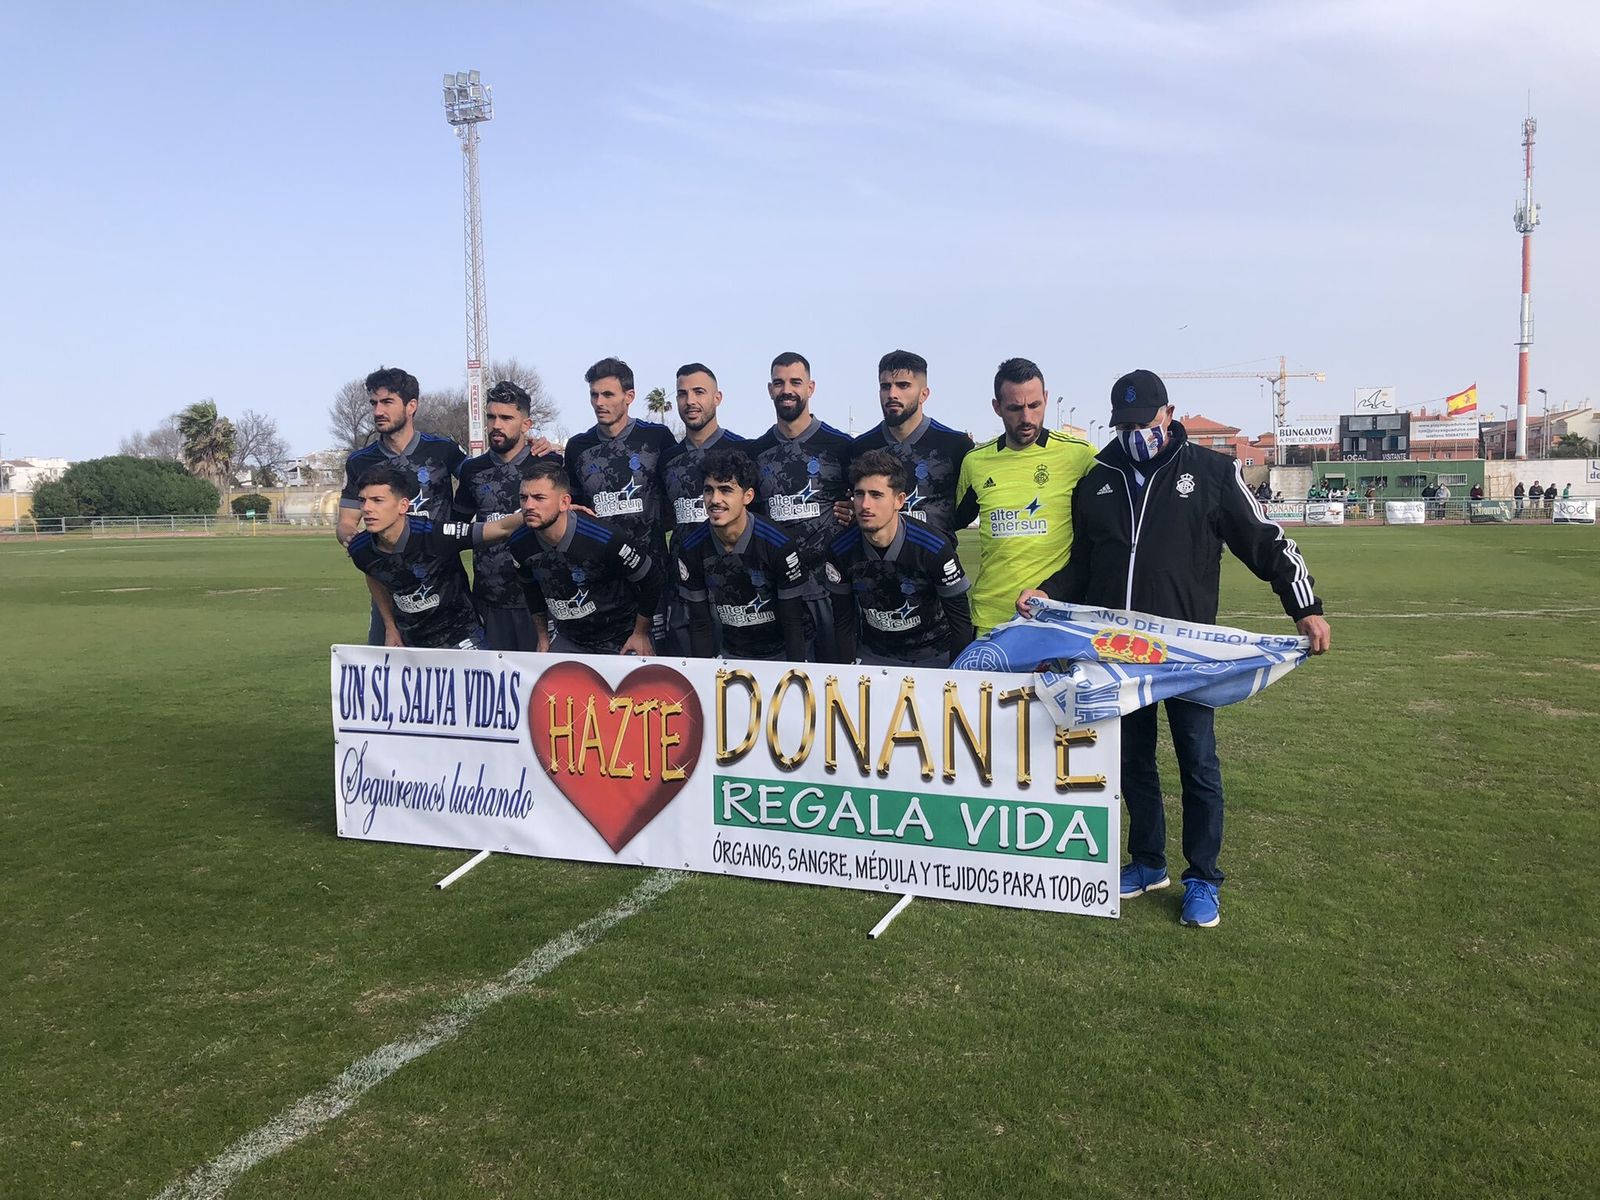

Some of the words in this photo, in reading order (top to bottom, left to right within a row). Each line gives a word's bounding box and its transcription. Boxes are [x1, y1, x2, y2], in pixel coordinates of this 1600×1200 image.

[1279, 427, 1333, 437] BUNGALOWS
[1382, 453, 1407, 461] VISITANTE
[593, 491, 621, 504] alter
[674, 497, 698, 509] alter
[769, 494, 795, 507] alter
[595, 499, 643, 513] enersun
[770, 503, 819, 518] enersun
[1268, 504, 1303, 512] DONANTE
[990, 509, 1020, 521] alter
[991, 519, 1047, 532] enersun
[1134, 618, 1166, 634] DEL
[339, 664, 366, 721] UN
[371, 653, 394, 729] SÍ,
[400, 666, 457, 726] SALVA
[464, 668, 520, 731] VIDAS
[715, 667, 1107, 790] DONANTE
[549, 694, 686, 781] HAZTE
[340, 741, 446, 834] Seguiremos
[450, 762, 534, 820] luchando
[721, 780, 934, 841] REGALA
[959, 801, 1099, 857] VIDA
[712, 833, 785, 873] ÓRGANOS,
[788, 848, 853, 881] SANGRE,
[855, 850, 919, 885] MÉDULA
[920, 862, 936, 885] Y
[933, 863, 999, 894] TEJIDOS
[1002, 872, 1046, 899] PARA
[1049, 875, 1110, 908] TOD@S
